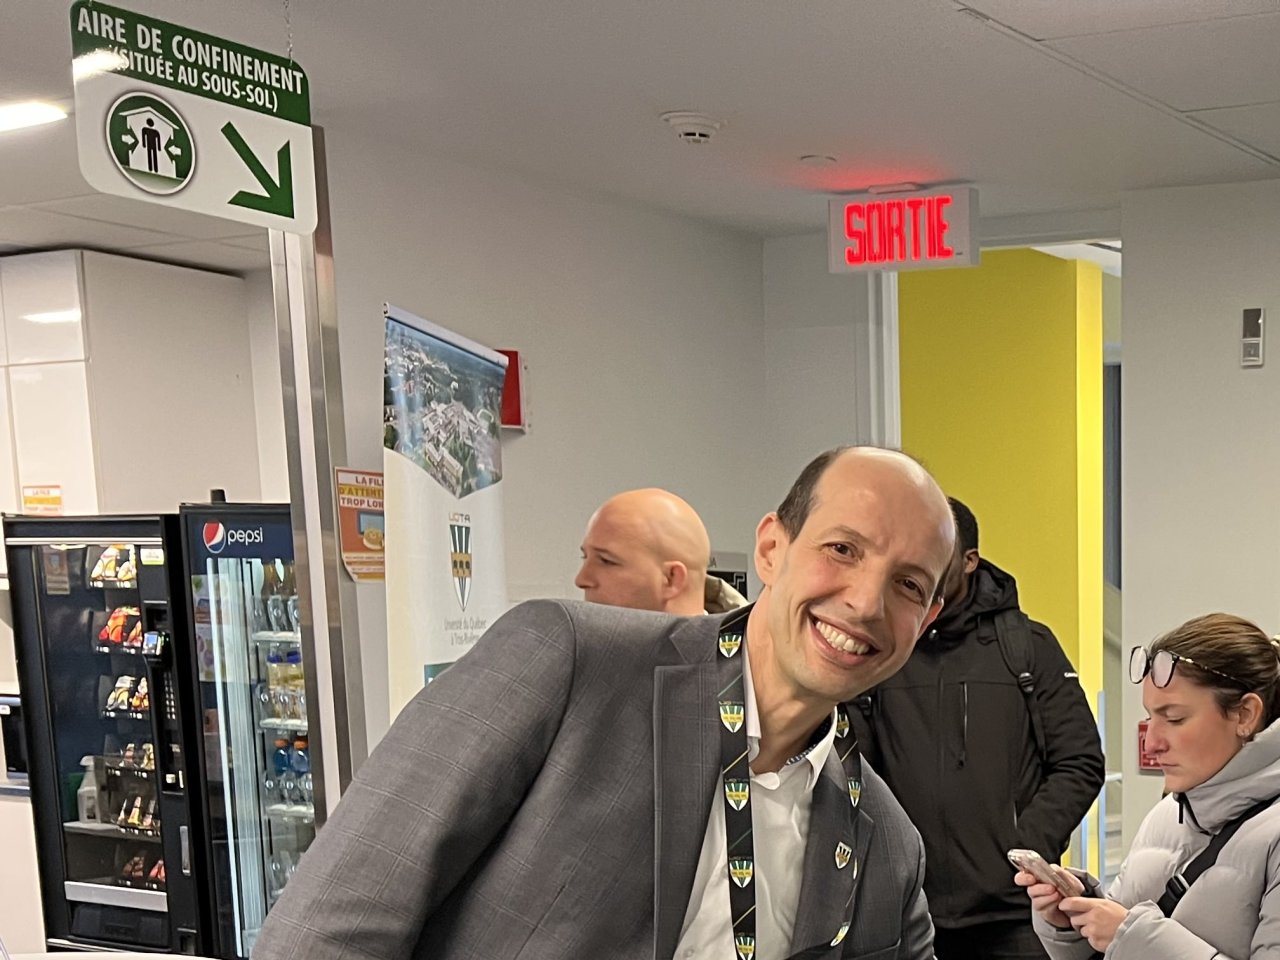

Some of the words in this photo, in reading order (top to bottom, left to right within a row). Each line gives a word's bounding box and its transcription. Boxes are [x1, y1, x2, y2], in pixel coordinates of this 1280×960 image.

[78, 7, 127, 44] AIRE
[136, 23, 163, 53] DE
[172, 34, 304, 95] CONFINEMENT
[177, 65, 198, 88] AU
[202, 71, 278, 113] SOUS-SOL)
[844, 195, 954, 266] SORTIE
[341, 496, 366, 507] TROP
[367, 499, 384, 509] LON
[227, 526, 264, 546] pepsi
